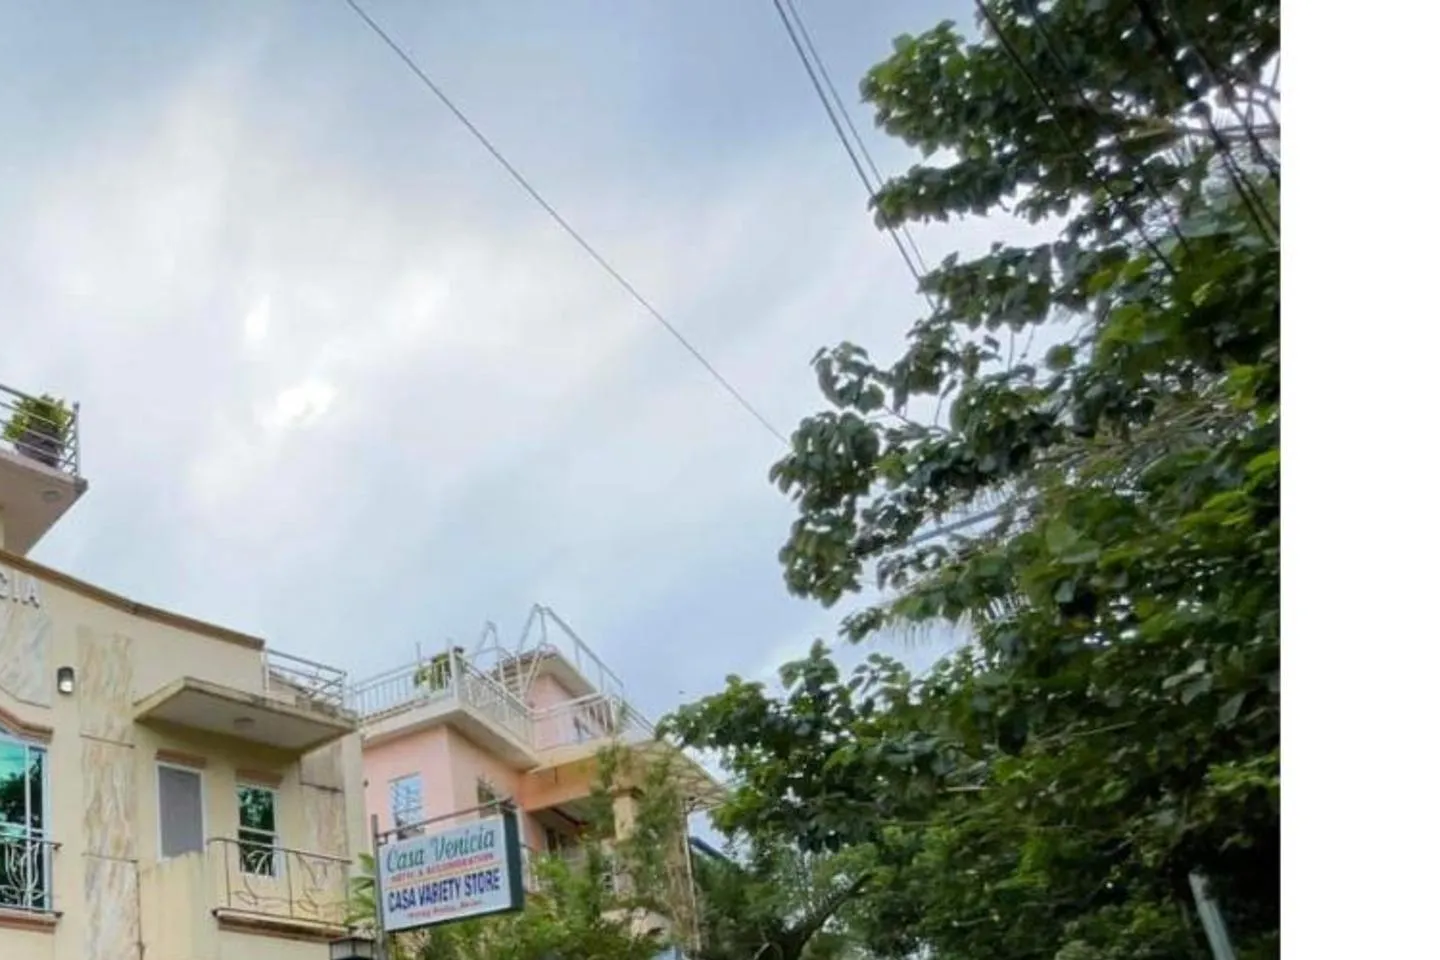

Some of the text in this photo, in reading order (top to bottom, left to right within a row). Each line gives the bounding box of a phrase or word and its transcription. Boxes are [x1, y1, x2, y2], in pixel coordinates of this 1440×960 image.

[386, 827, 495, 873] Casa Venicia
[388, 886, 417, 914] CASA
[418, 876, 462, 907] VARIETY
[464, 867, 501, 897] STORE
